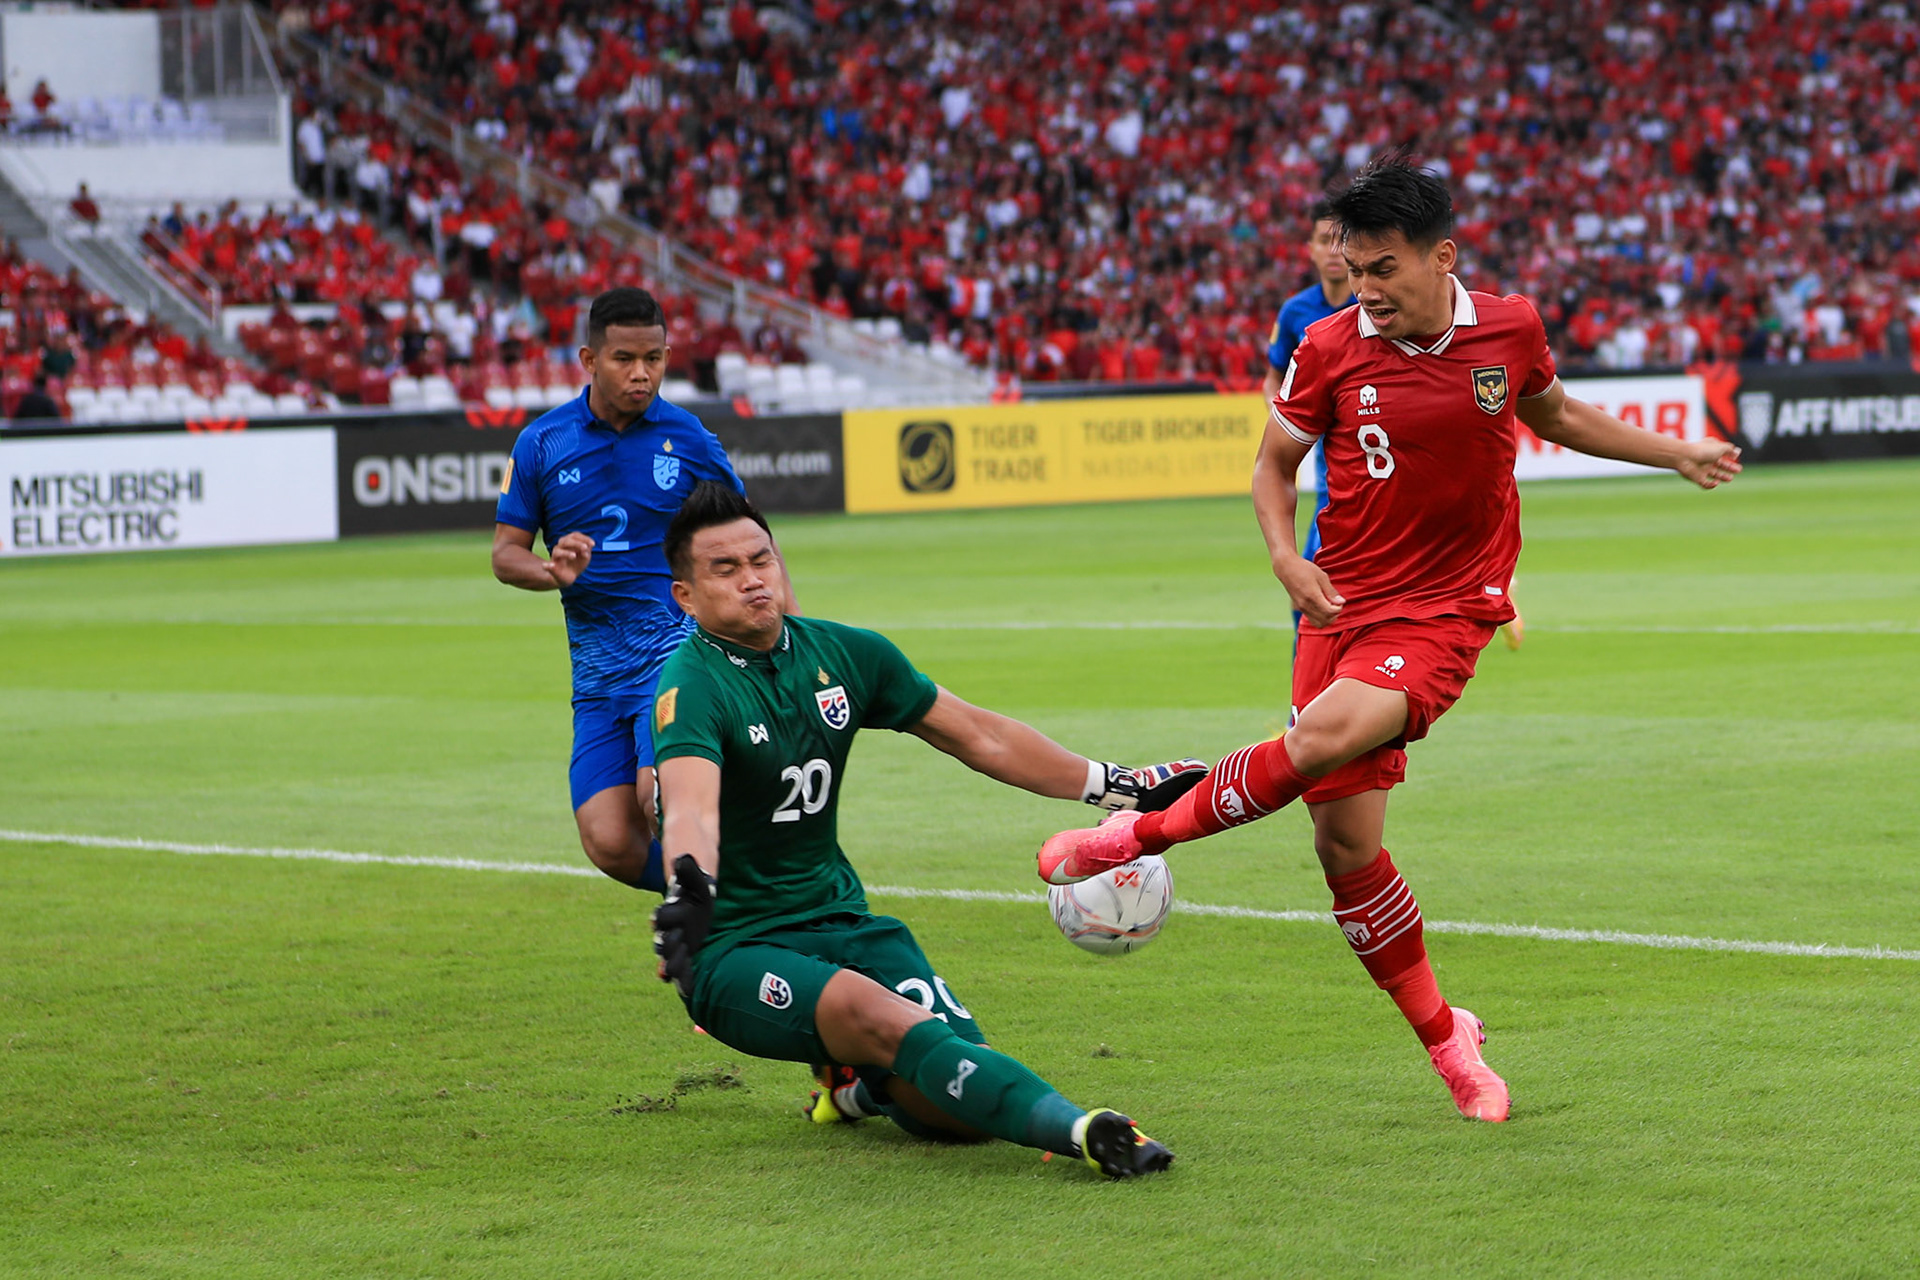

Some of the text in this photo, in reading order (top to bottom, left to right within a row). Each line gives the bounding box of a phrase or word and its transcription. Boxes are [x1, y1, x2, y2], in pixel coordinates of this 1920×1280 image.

[1082, 414, 1252, 445] TIGER BROKERS
[1356, 406, 1381, 417] MILLS
[1776, 398, 1829, 436] AFF
[969, 423, 1038, 449] TIGER
[1357, 423, 1396, 480] 8
[969, 454, 1047, 484] TRADE
[1082, 449, 1253, 479] NASDAQ LISTED
[11, 469, 204, 508] MITSUBISHI
[12, 508, 180, 548] ELECTRIC
[601, 504, 630, 551] 2
[771, 758, 832, 823] 20
